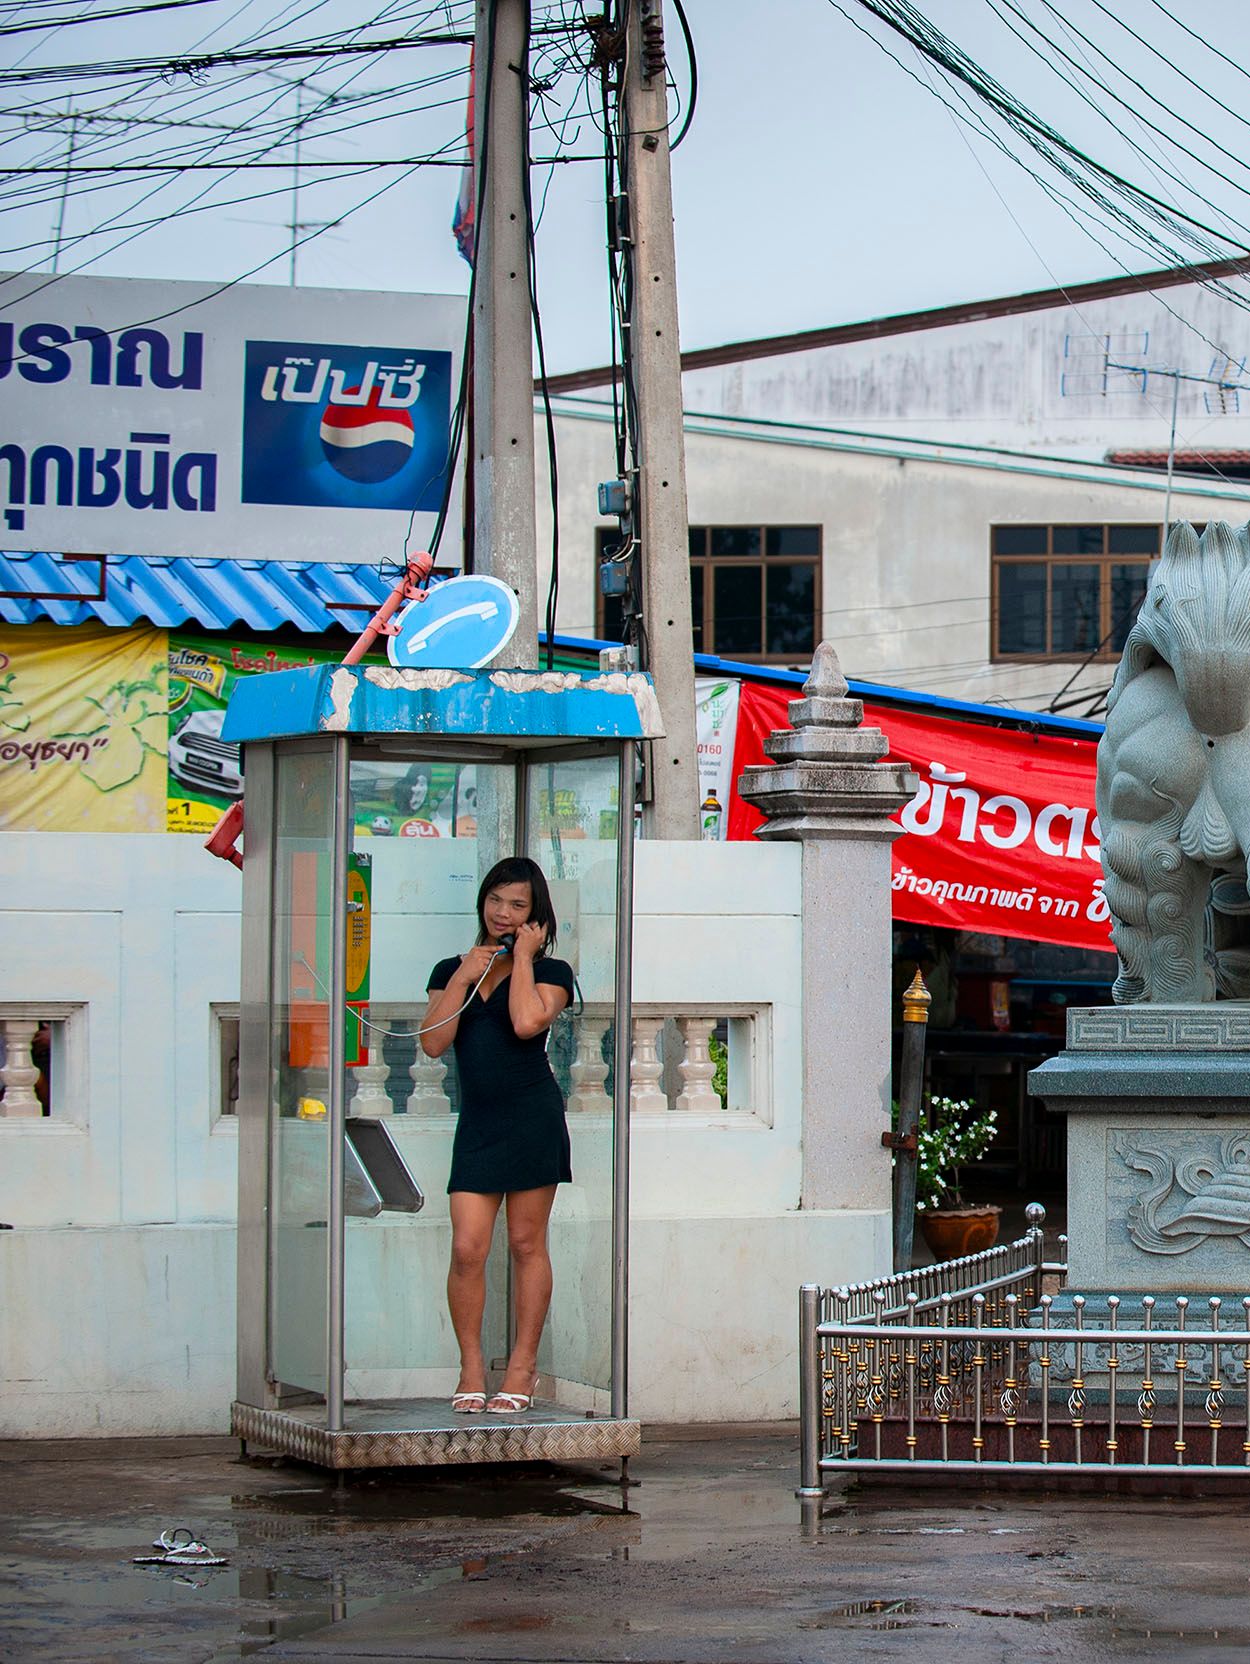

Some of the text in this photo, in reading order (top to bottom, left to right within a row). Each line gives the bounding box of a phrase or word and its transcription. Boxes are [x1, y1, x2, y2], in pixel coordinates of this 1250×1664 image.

[261, 357, 426, 407] เป๊ปซี่
[181, 802, 190, 815] 1
[891, 866, 1037, 905] ข้าวคุณภาพดี
[1038, 896, 1080, 917] จาก
